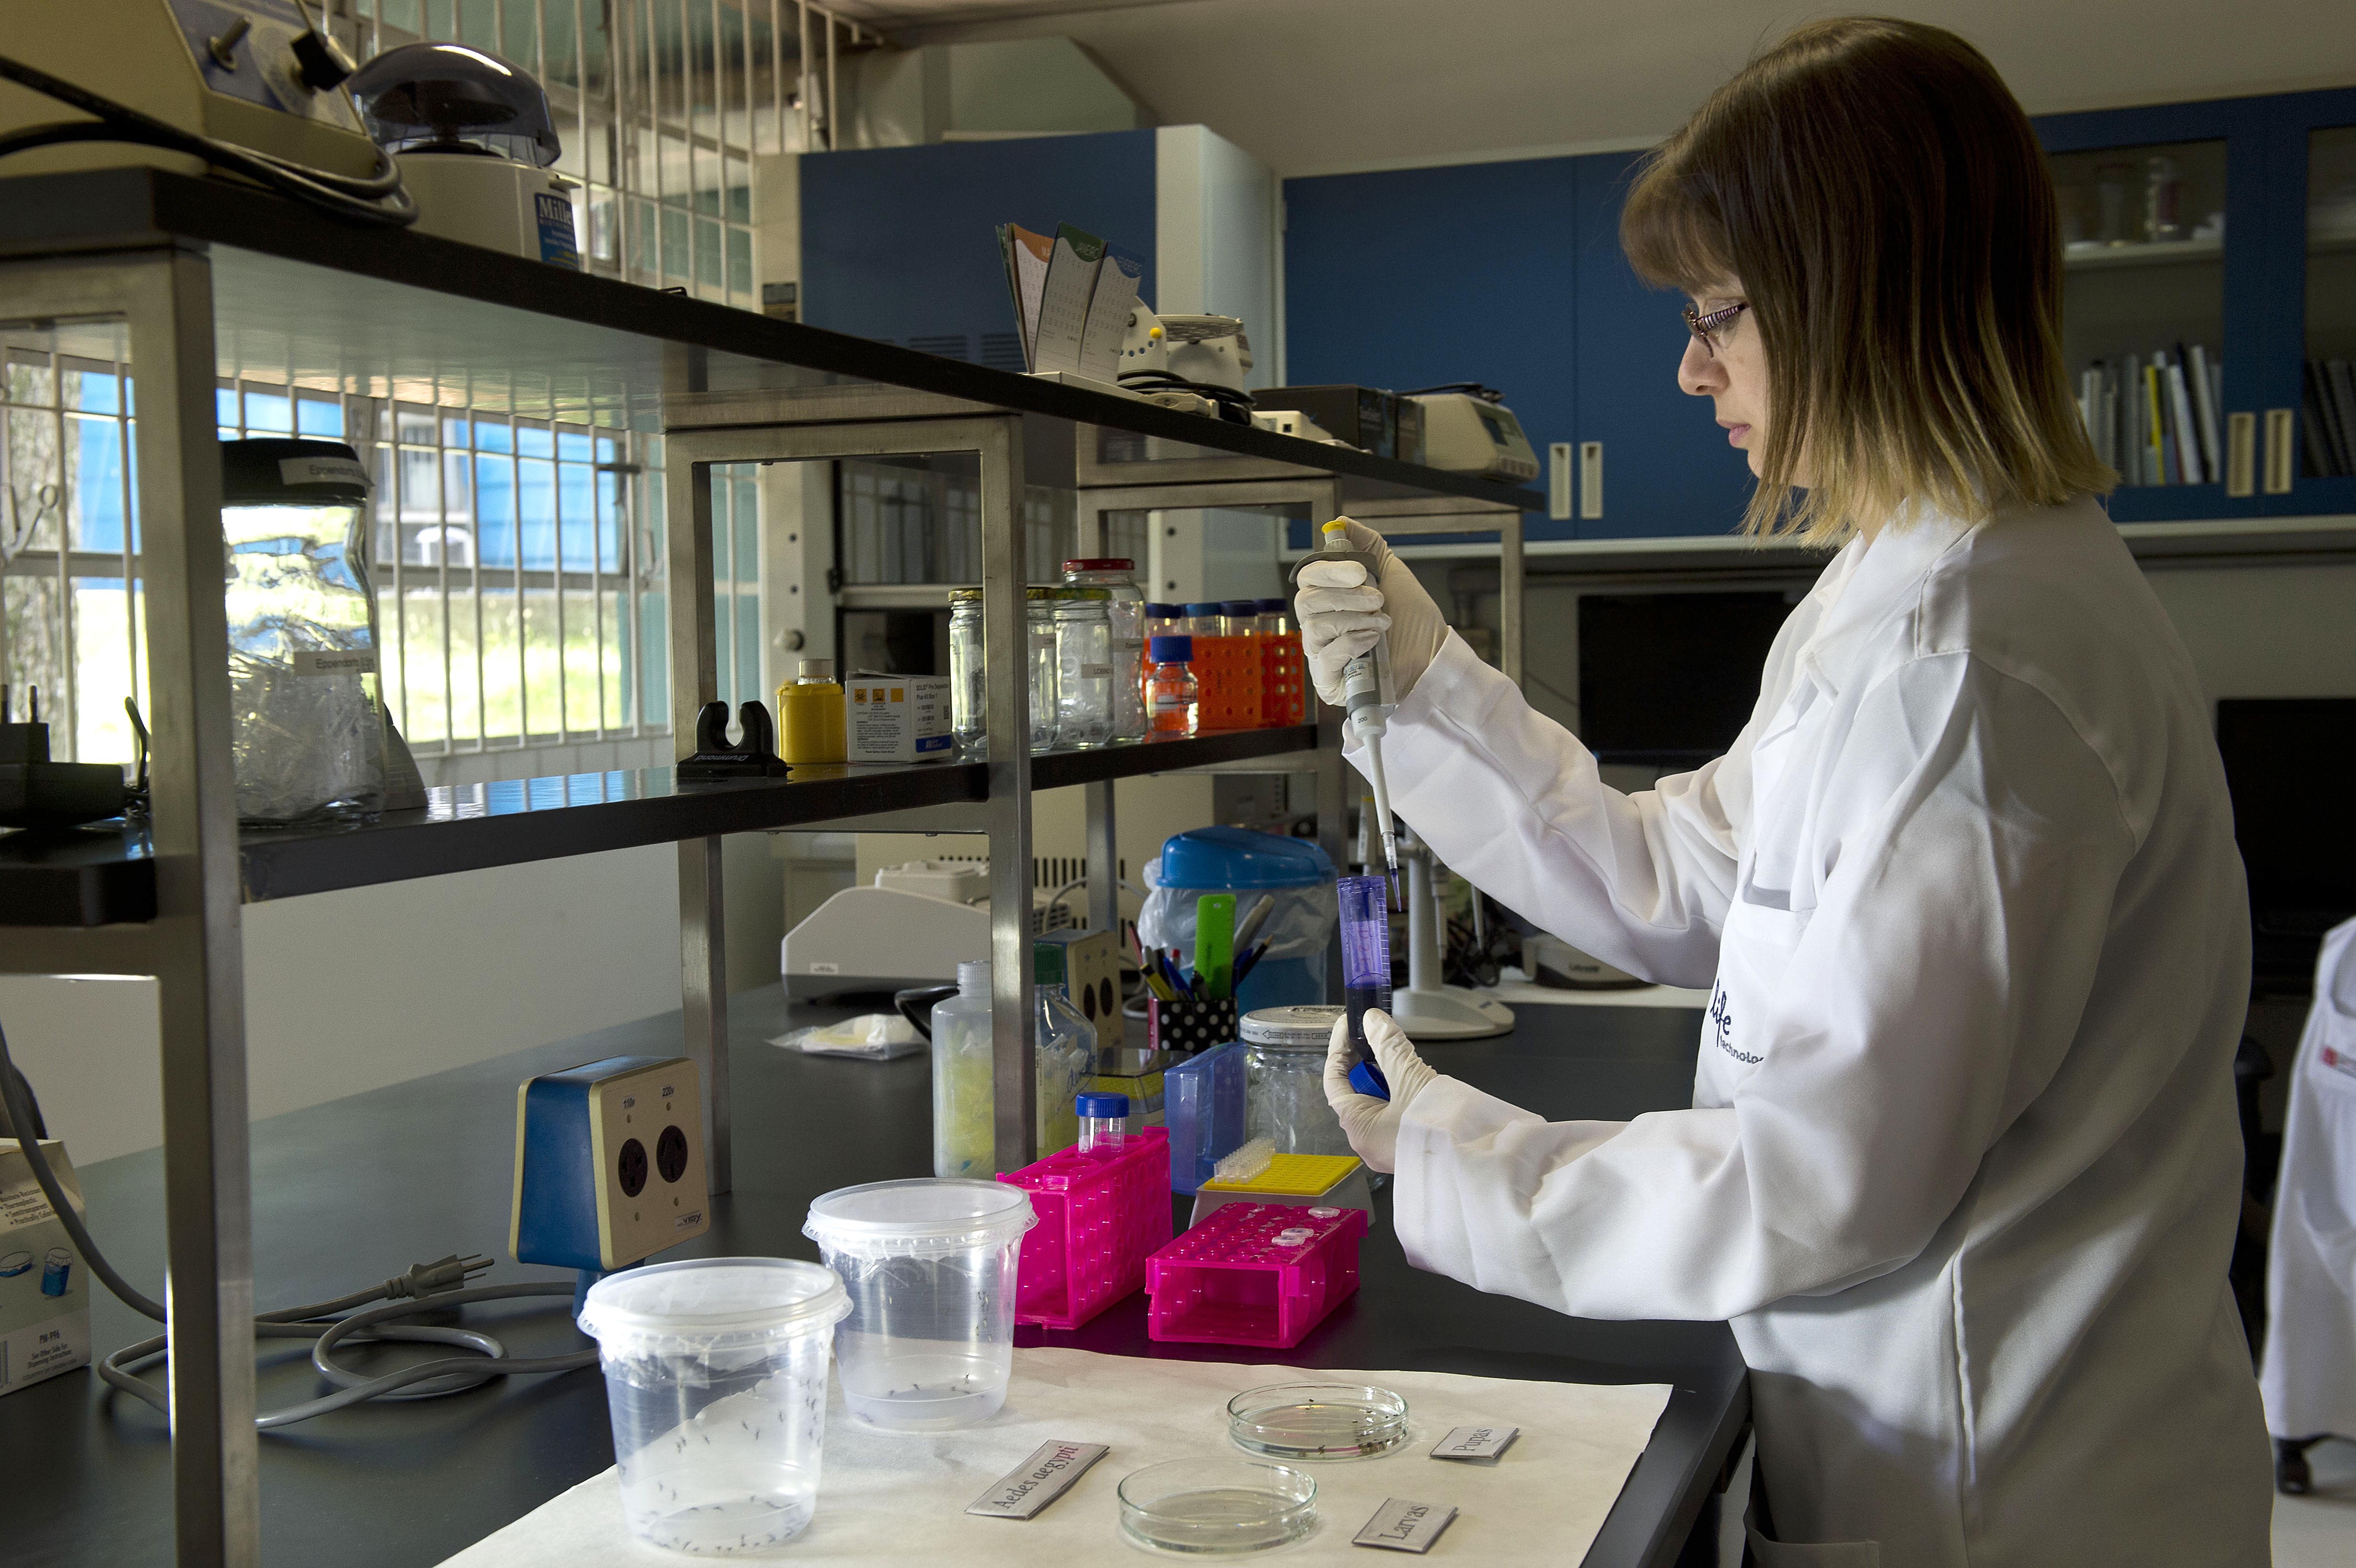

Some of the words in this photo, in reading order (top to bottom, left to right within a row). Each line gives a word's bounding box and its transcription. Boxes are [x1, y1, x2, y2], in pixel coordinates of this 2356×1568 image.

[1710, 978, 1732, 1048] life
[1452, 1428, 1493, 1451] Pupas
[992, 1480, 1039, 1509] Aedes
[1033, 1445, 1079, 1480] aegypti
[1379, 1505, 1429, 1540] Larvas
